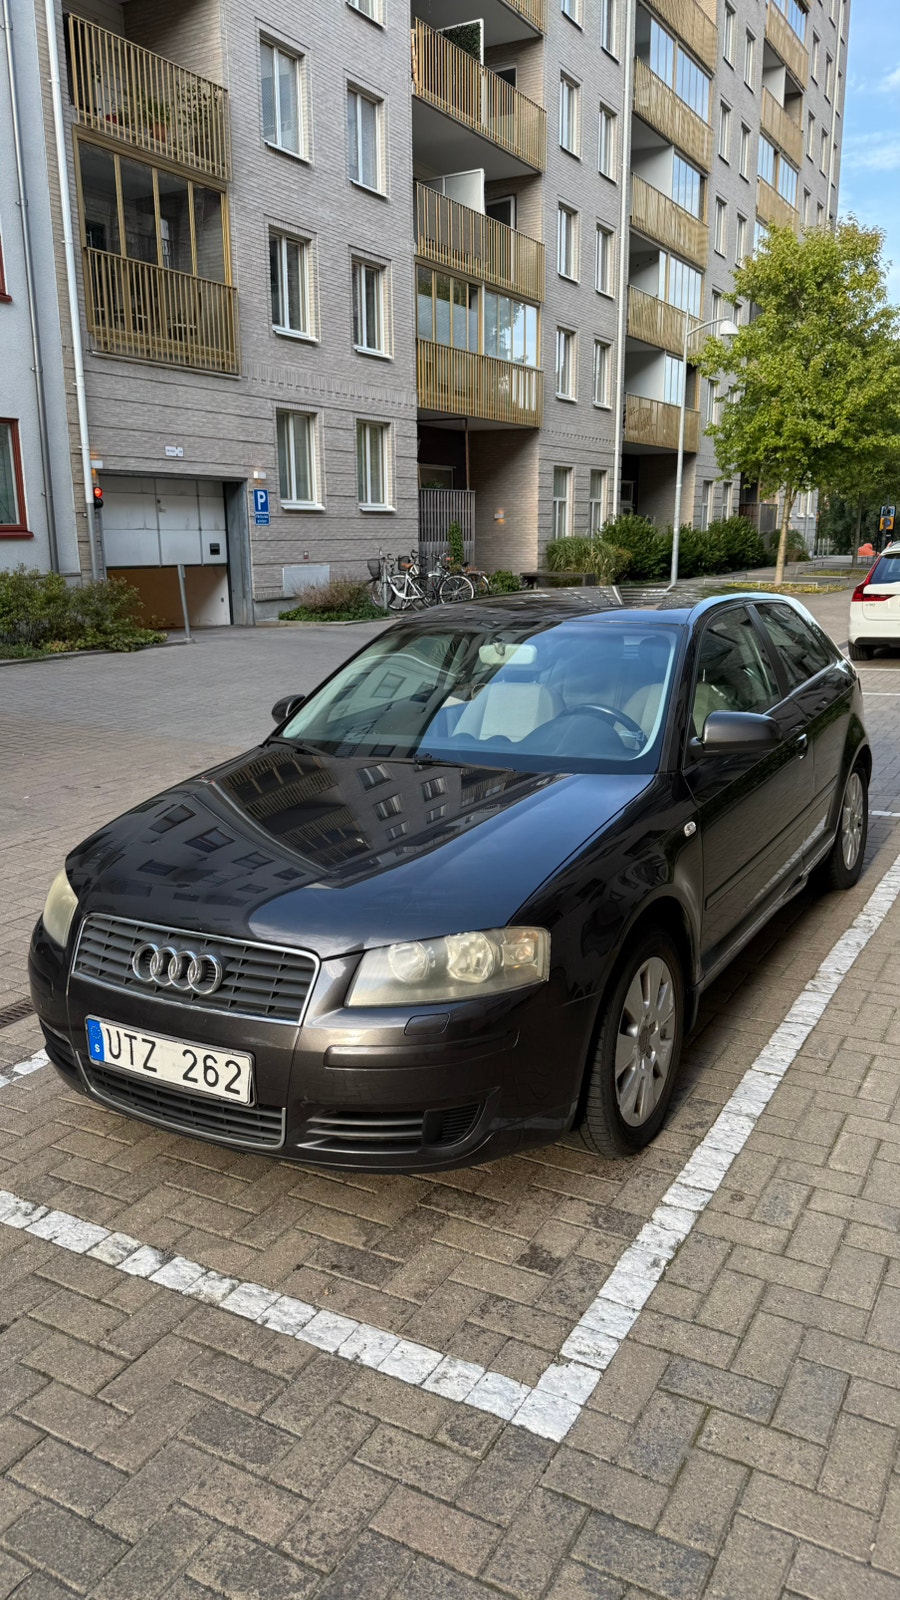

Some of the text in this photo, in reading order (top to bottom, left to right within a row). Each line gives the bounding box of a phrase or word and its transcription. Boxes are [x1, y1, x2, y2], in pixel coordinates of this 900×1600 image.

[257, 491, 266, 511] P
[94, 1043, 101, 1053] S
[106, 1028, 242, 1096] UTZ 262
